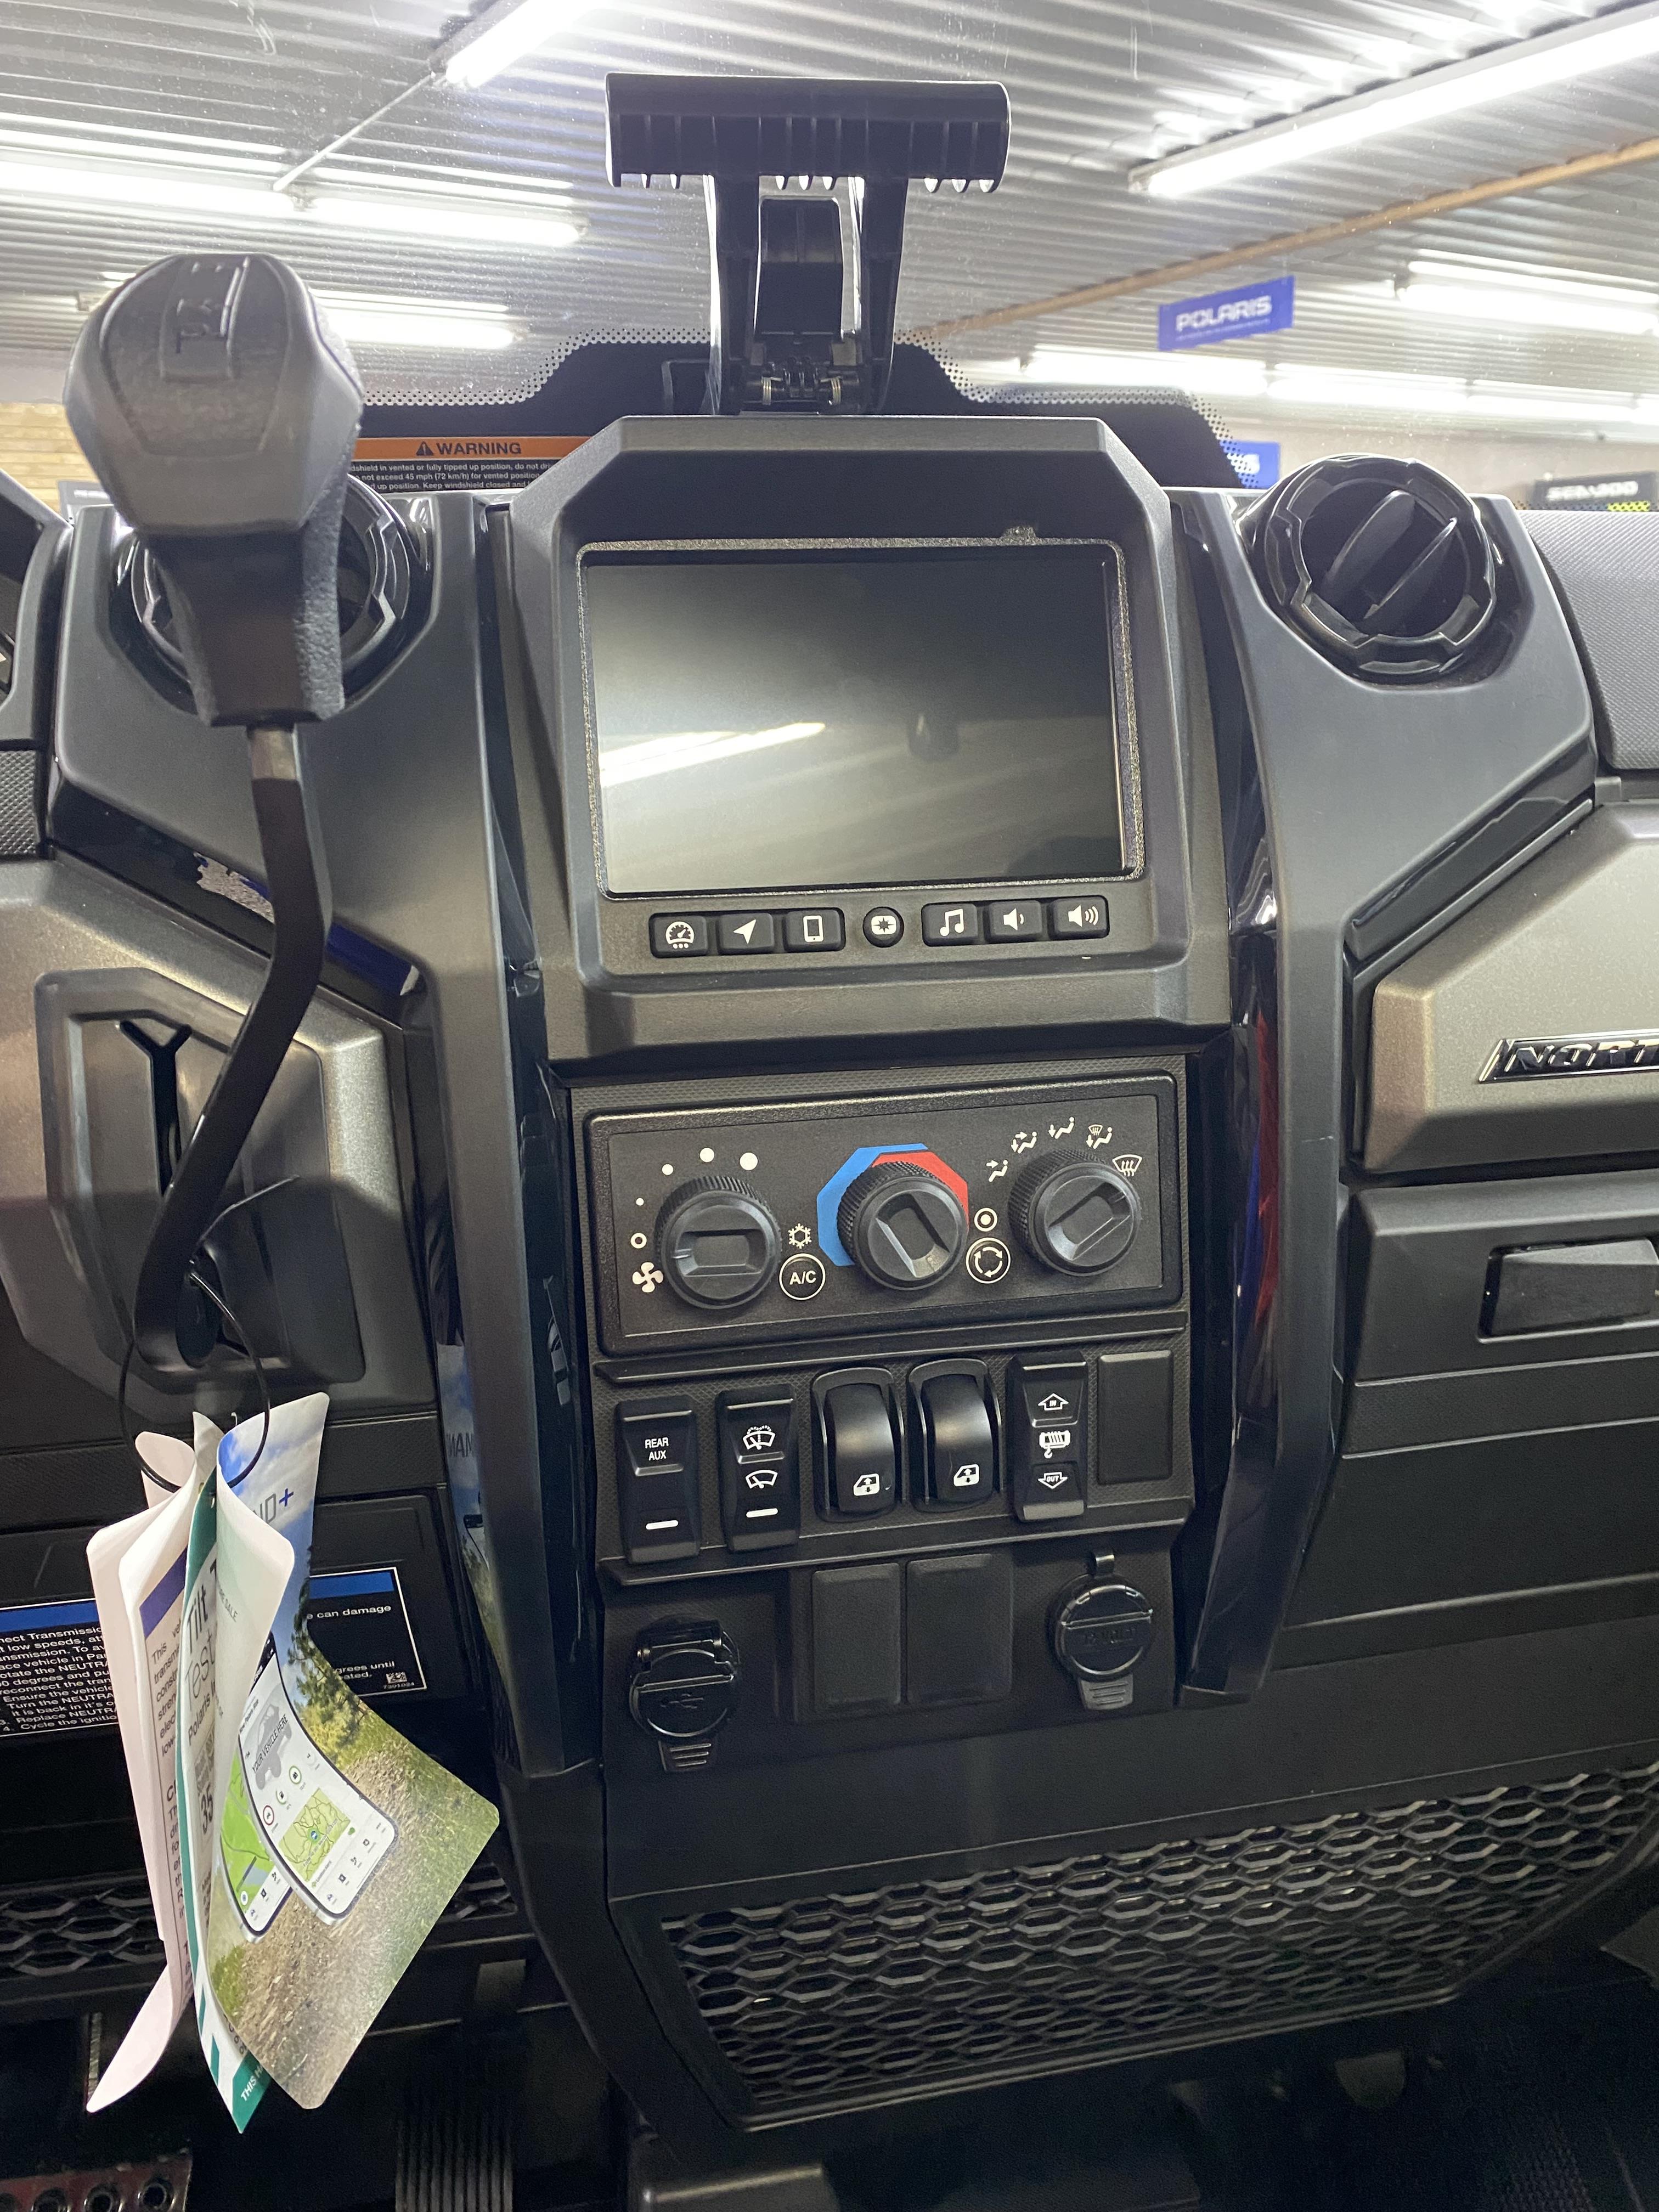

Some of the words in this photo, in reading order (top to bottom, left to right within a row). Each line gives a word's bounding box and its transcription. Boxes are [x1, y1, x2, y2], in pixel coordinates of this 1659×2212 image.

[1176, 295, 1272, 332] POLARIS
[436, 442, 522, 455] WARNING
[789, 1270, 816, 1285] A/C
[645, 1437, 669, 1449] REAR
[648, 1450, 667, 1461] AUX
[342, 1605, 392, 1616] damage
[187, 1584, 208, 1655] Tilt
[34, 1638, 85, 1649] speeds,
[151, 1643, 167, 1664] This
[23, 1657, 68, 1667] vehicle
[370, 1661, 396, 1669] until
[184, 1629, 216, 1712] Test
[13, 1675, 64, 1685] degrees
[67, 1671, 90, 1679] and
[3, 1694, 46, 1702] Ensure
[16, 1714, 66, 1723] Replace
[69, 1708, 116, 1717] NEUTR
[36, 1706, 67, 1714] back
[188, 1692, 211, 1746] Polaris
[252, 1753, 264, 1774] YOUR
[262, 1729, 279, 1757] VEHICLE
[276, 1714, 289, 1734] HERE
[241, 2075, 257, 2102] THIS
